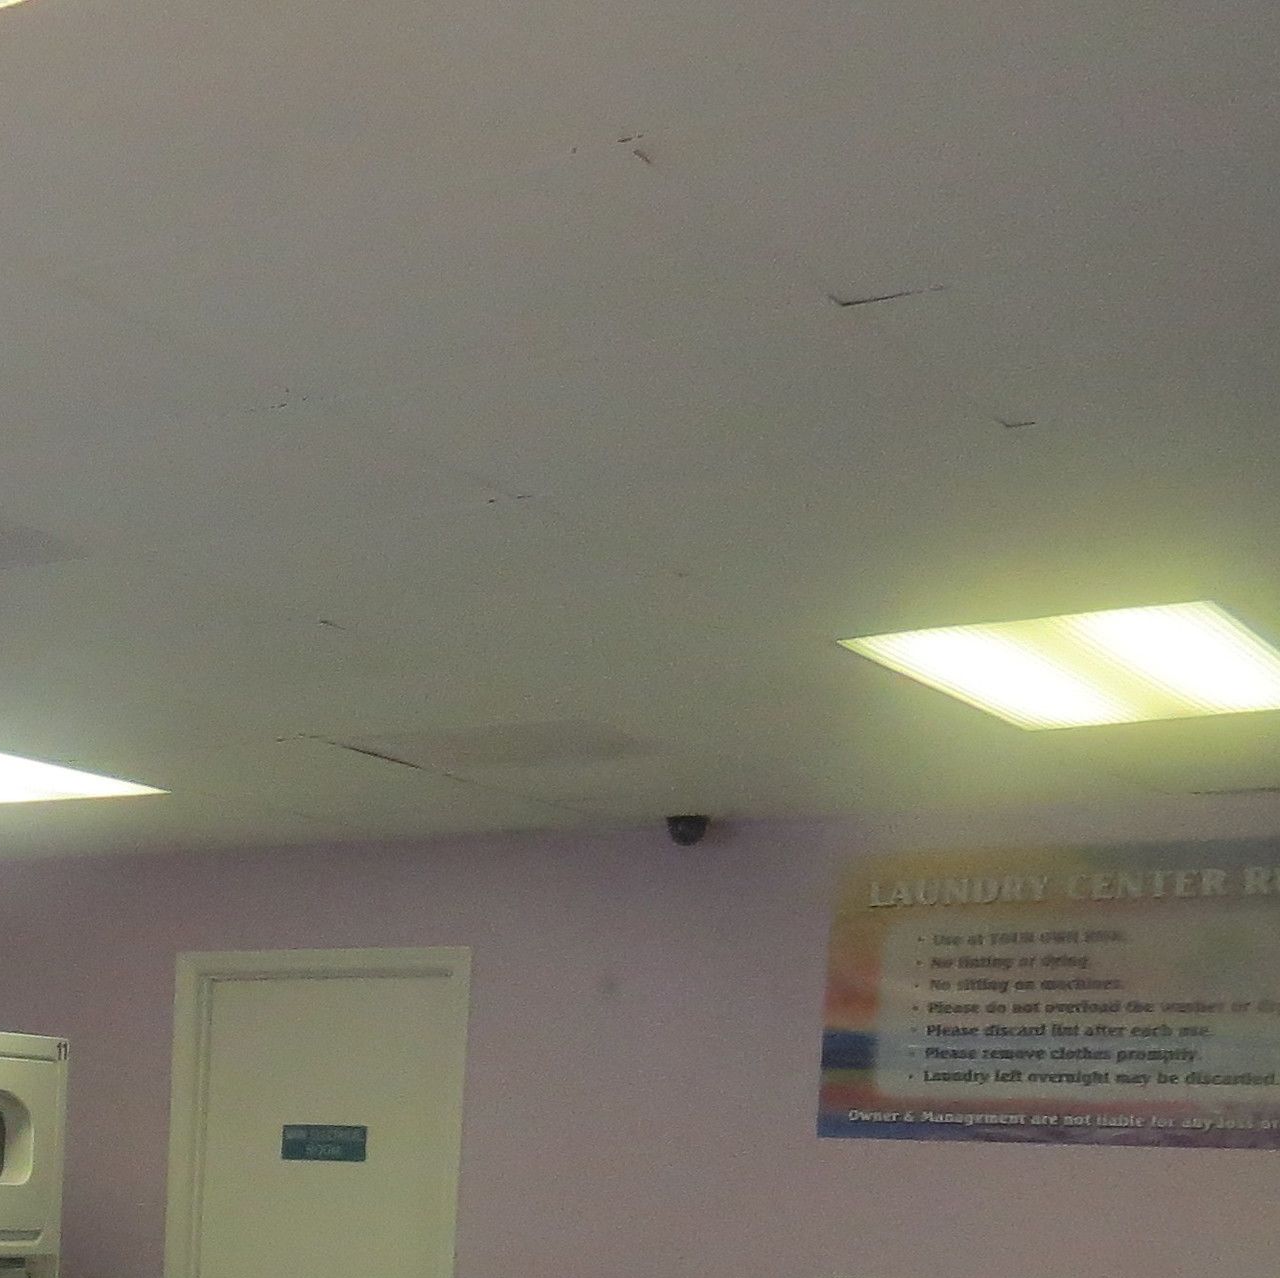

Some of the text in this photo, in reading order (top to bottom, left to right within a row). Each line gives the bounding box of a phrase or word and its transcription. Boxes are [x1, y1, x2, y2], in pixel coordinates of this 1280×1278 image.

[867, 874, 1049, 907] LAUNDRY
[1067, 868, 1228, 901] CENTER
[929, 980, 952, 991] No
[928, 1002, 980, 1014] Please
[986, 1002, 1007, 1014] do
[1011, 1003, 1040, 1014] not
[1045, 1002, 1121, 1014] overload
[1125, 1001, 1154, 1013] the
[927, 1024, 979, 1037] Please
[985, 1024, 1046, 1037] discard
[1051, 1024, 1080, 1037] lint
[1083, 1024, 1127, 1037] after
[1130, 1024, 1173, 1037] each
[56, 1041, 69, 1060] 11
[925, 1047, 977, 1059] Please
[982, 1048, 1045, 1059] remove
[1050, 1047, 1111, 1060] clothes
[924, 1069, 990, 1084] Laundry
[994, 1069, 1024, 1082] left
[1028, 1071, 1109, 1086] overnight
[1115, 1073, 1151, 1087] may
[1157, 1072, 1179, 1084] be
[848, 1108, 900, 1123] Owner
[904, 1111, 916, 1123] &
[921, 1111, 1026, 1126] Management
[1031, 1114, 1059, 1126] are
[1063, 1114, 1093, 1127] not
[1096, 1114, 1146, 1128] liable
[1151, 1116, 1175, 1128] for
[1182, 1117, 1214, 1131] any
